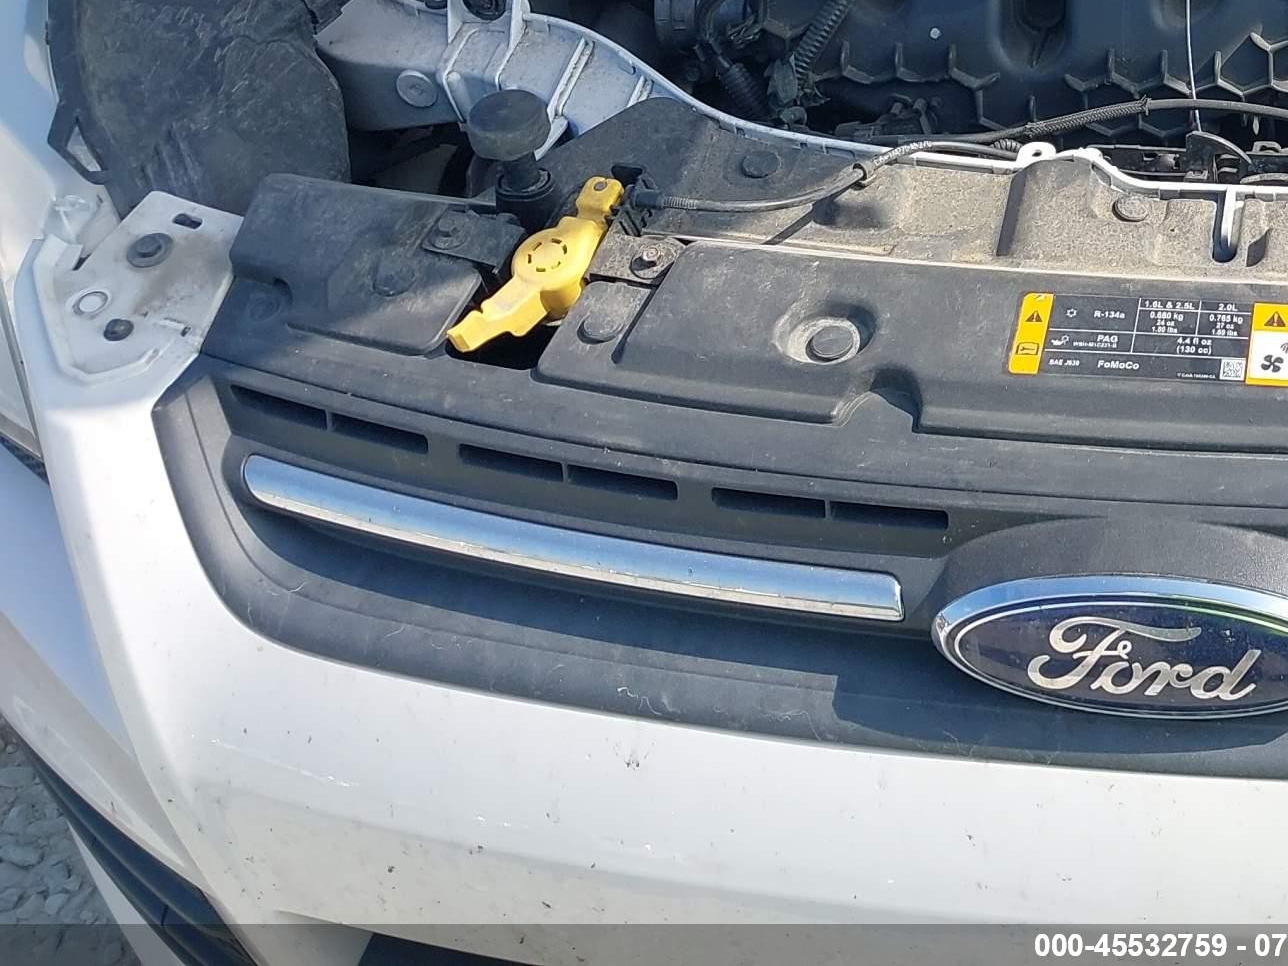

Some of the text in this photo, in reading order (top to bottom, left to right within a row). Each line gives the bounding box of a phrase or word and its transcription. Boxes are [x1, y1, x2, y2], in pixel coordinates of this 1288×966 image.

[1218, 303, 1238, 311] 2.0L
[1093, 310, 1126, 319] R-134a
[1173, 312, 1184, 321] kg
[1233, 315, 1243, 324] kg
[1097, 334, 1119, 343] PAG
[1176, 345, 1212, 355] (130 cc)
[1048, 358, 1064, 366] SAE
[1097, 360, 1140, 370] FoMoCo
[1027, 615, 1262, 702] Ford
